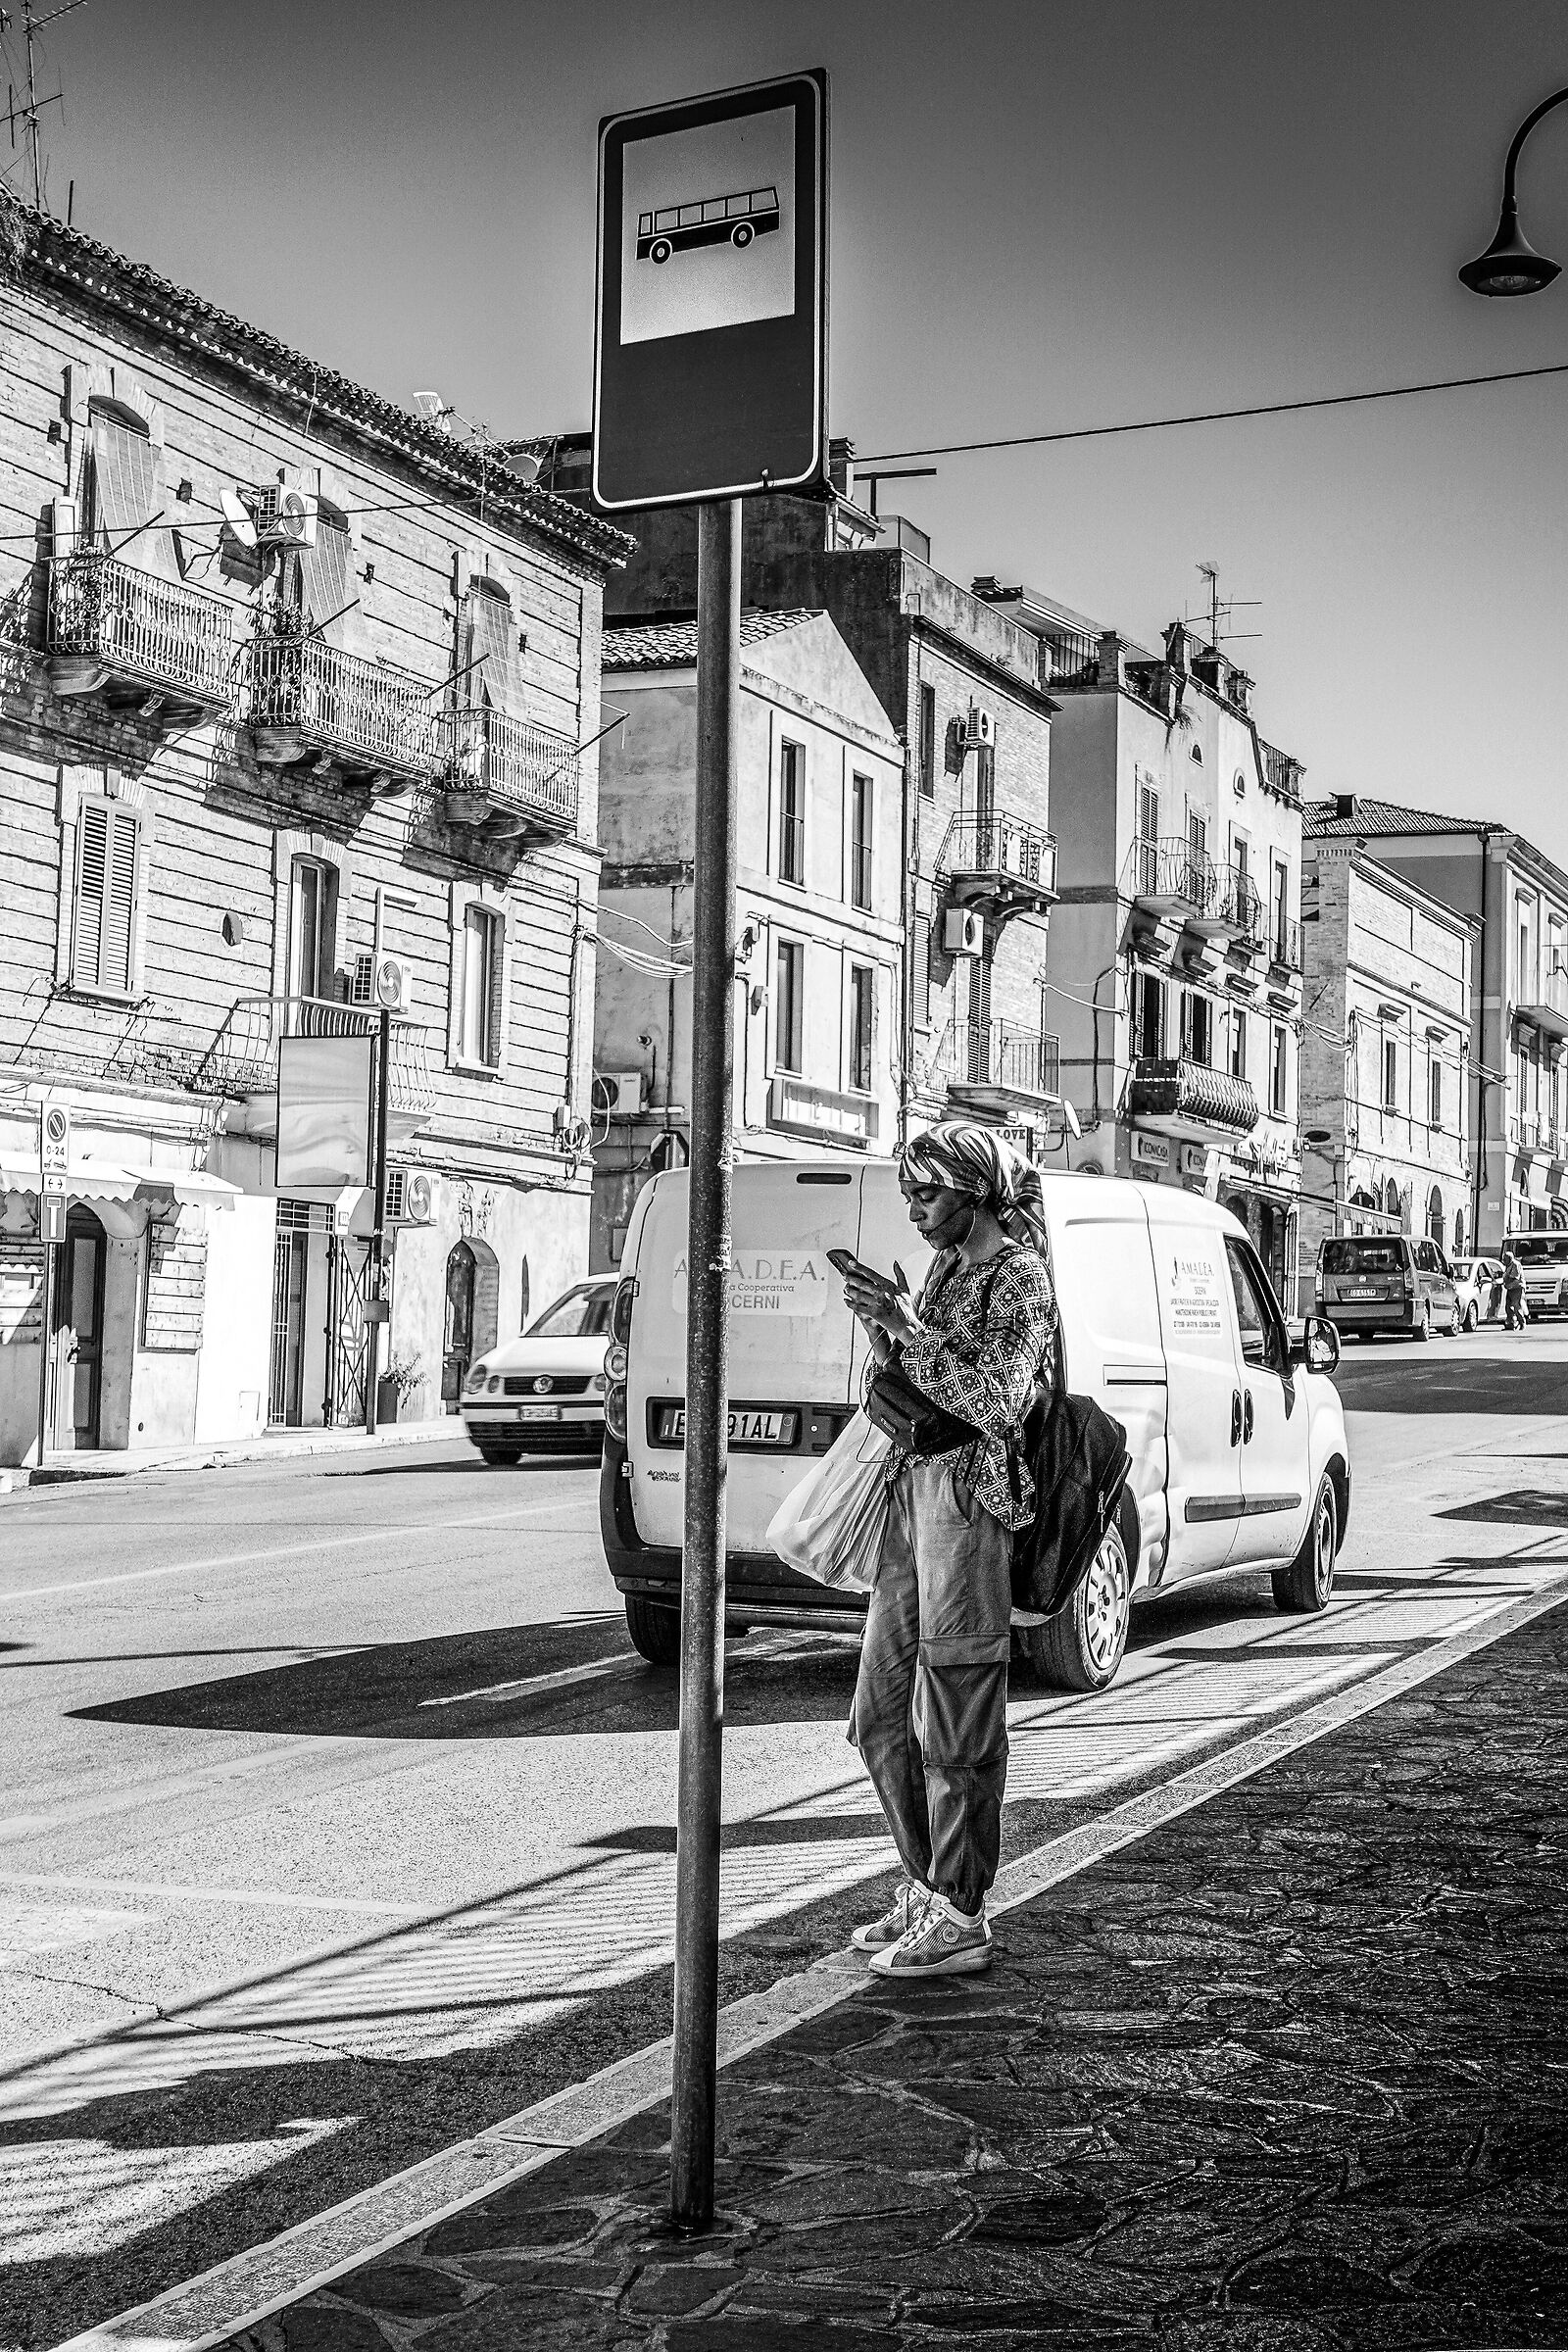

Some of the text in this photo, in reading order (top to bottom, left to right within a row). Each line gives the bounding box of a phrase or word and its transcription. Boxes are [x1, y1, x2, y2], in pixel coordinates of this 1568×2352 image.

[46, 1145, 65, 1156] 0-24
[737, 1282, 796, 1294] Cooperativa
[730, 1294, 780, 1309] CERNI
